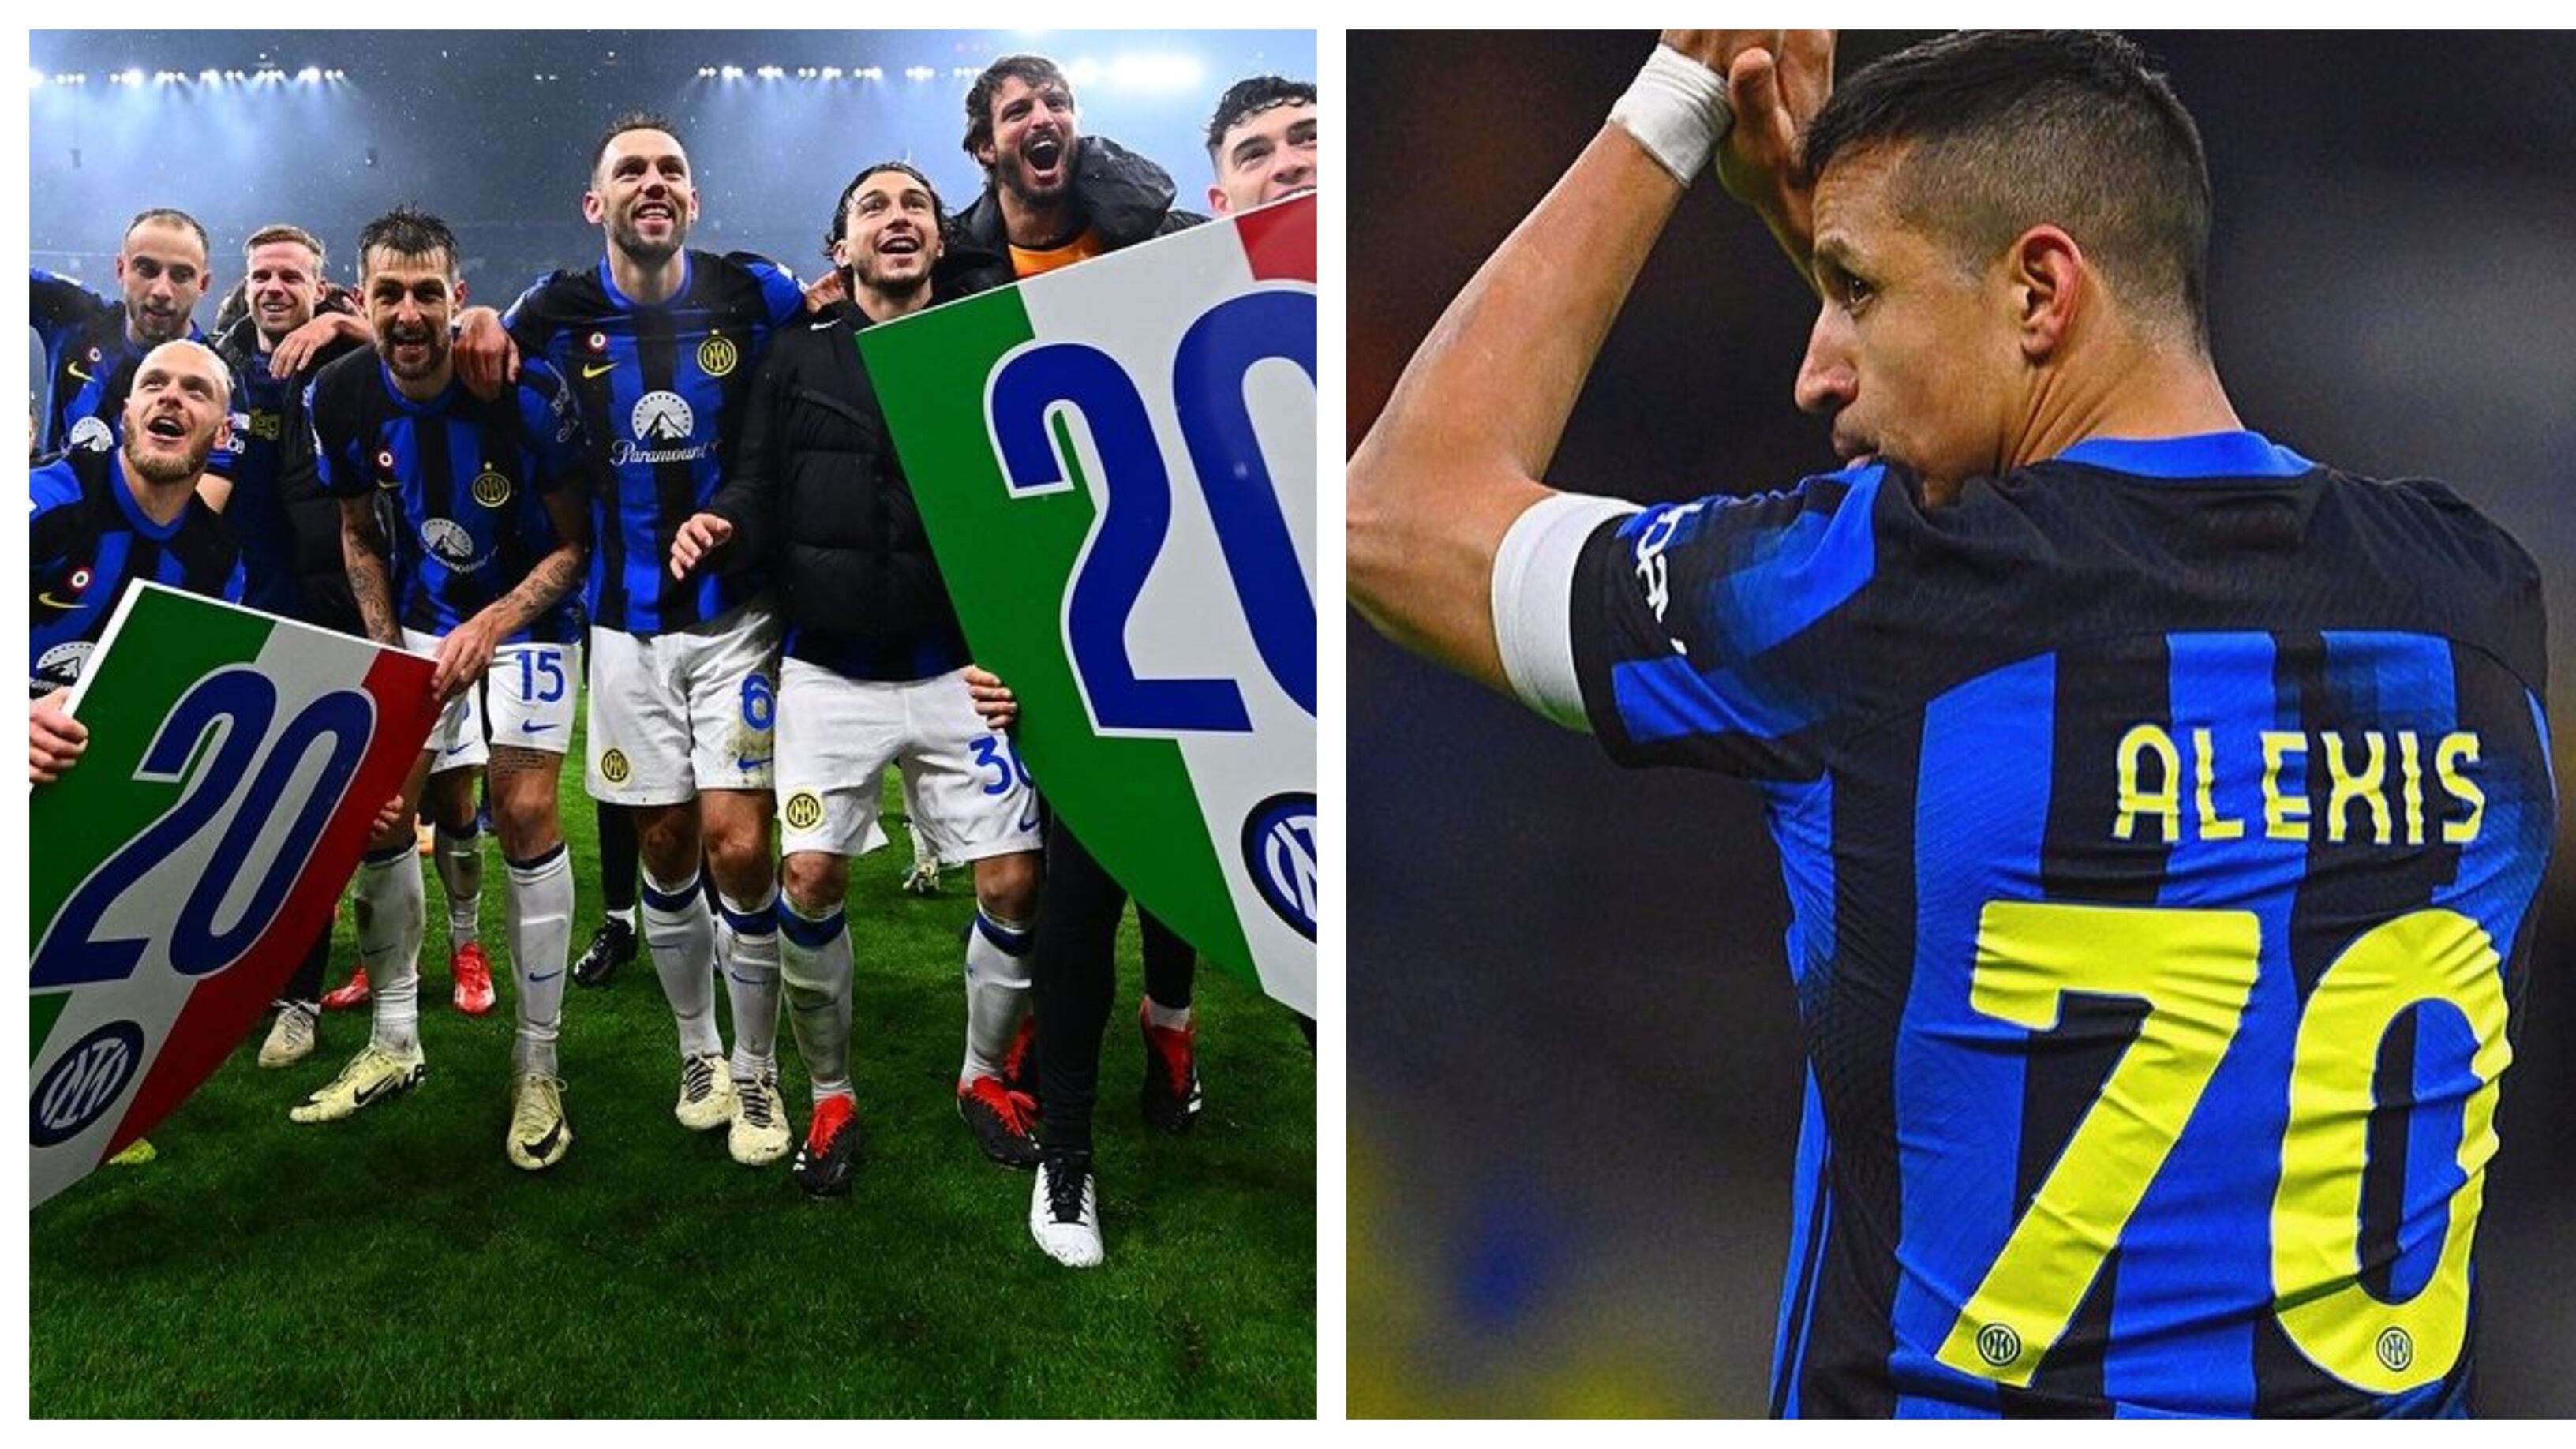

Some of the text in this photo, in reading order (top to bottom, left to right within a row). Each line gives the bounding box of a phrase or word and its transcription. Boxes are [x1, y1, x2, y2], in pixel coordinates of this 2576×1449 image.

[516, 650, 565, 703] 15
[740, 673, 776, 731] 6
[30, 668, 373, 987] 20
[2113, 724, 2487, 845] ALEXIS
[1934, 900, 2514, 1395] 70
